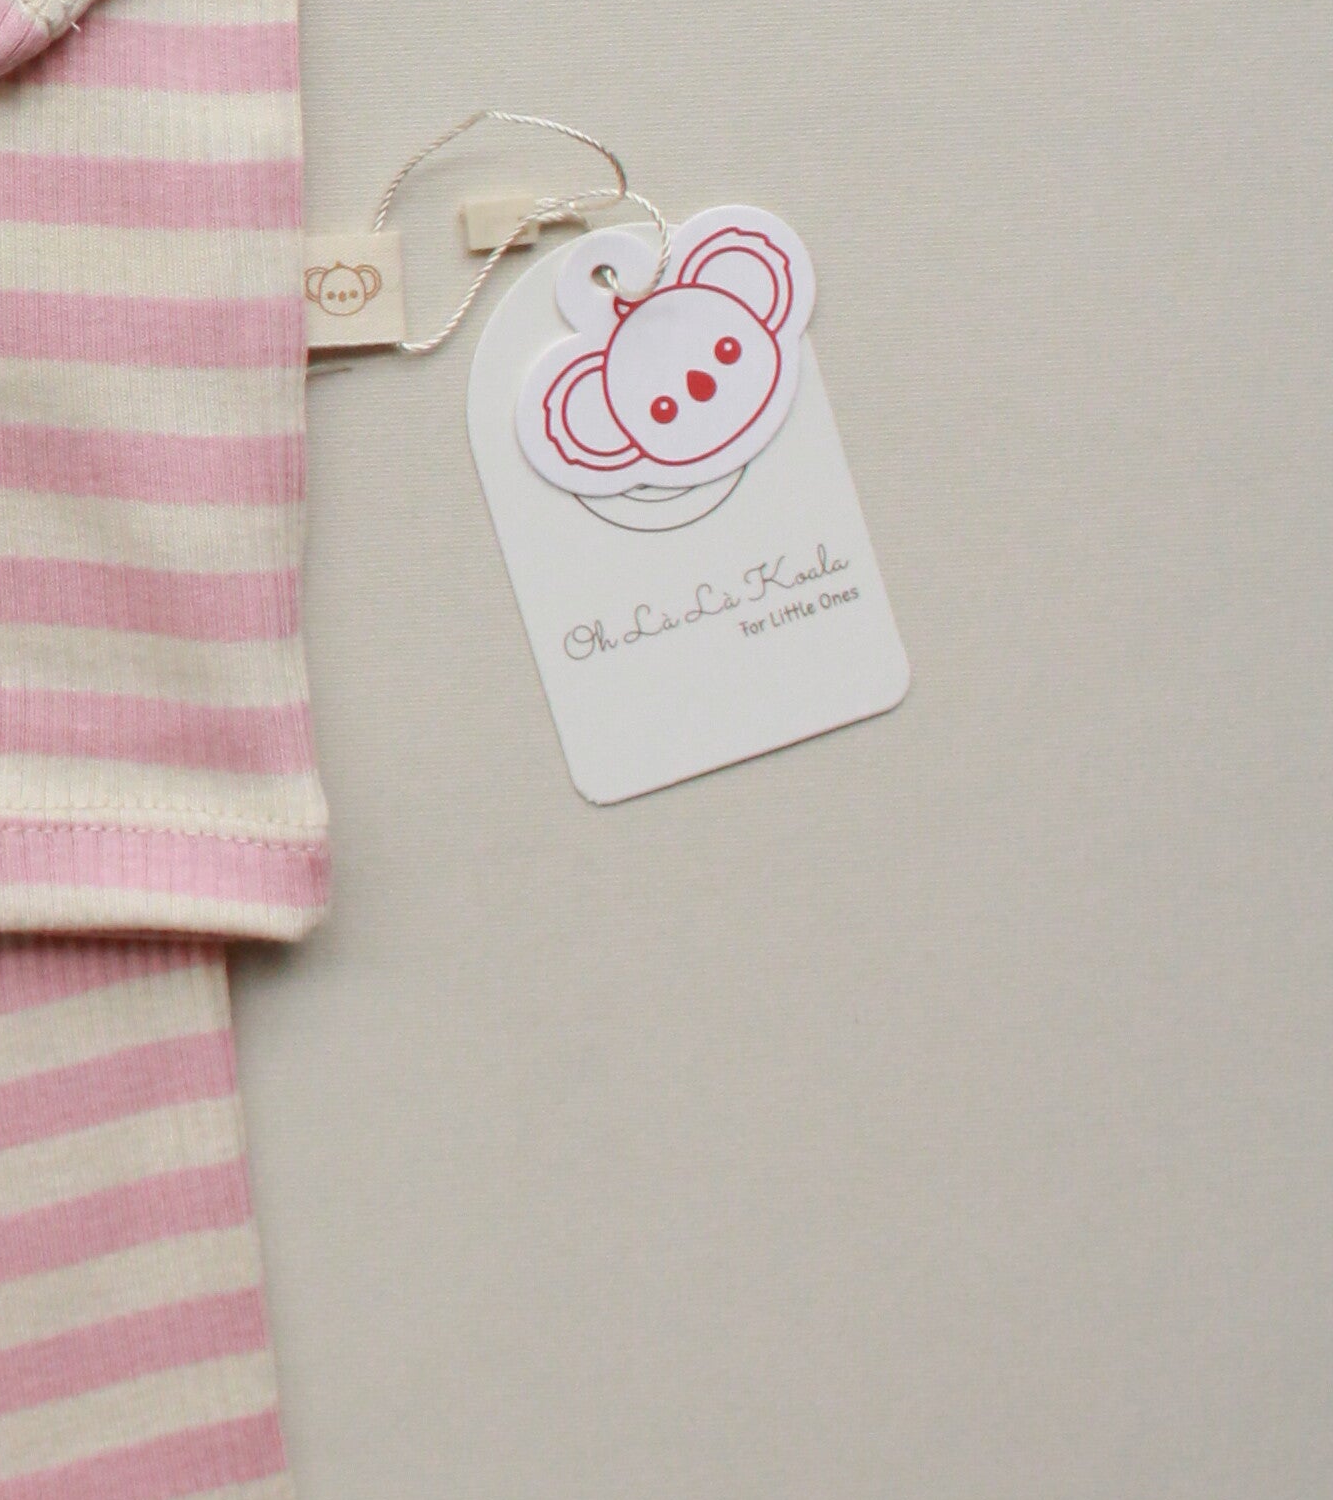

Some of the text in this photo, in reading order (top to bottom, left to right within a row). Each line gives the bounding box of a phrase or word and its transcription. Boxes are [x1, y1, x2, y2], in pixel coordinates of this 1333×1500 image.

[563, 542, 850, 661] Oh Là Là Koala
[738, 586, 860, 637] For Little Ones
